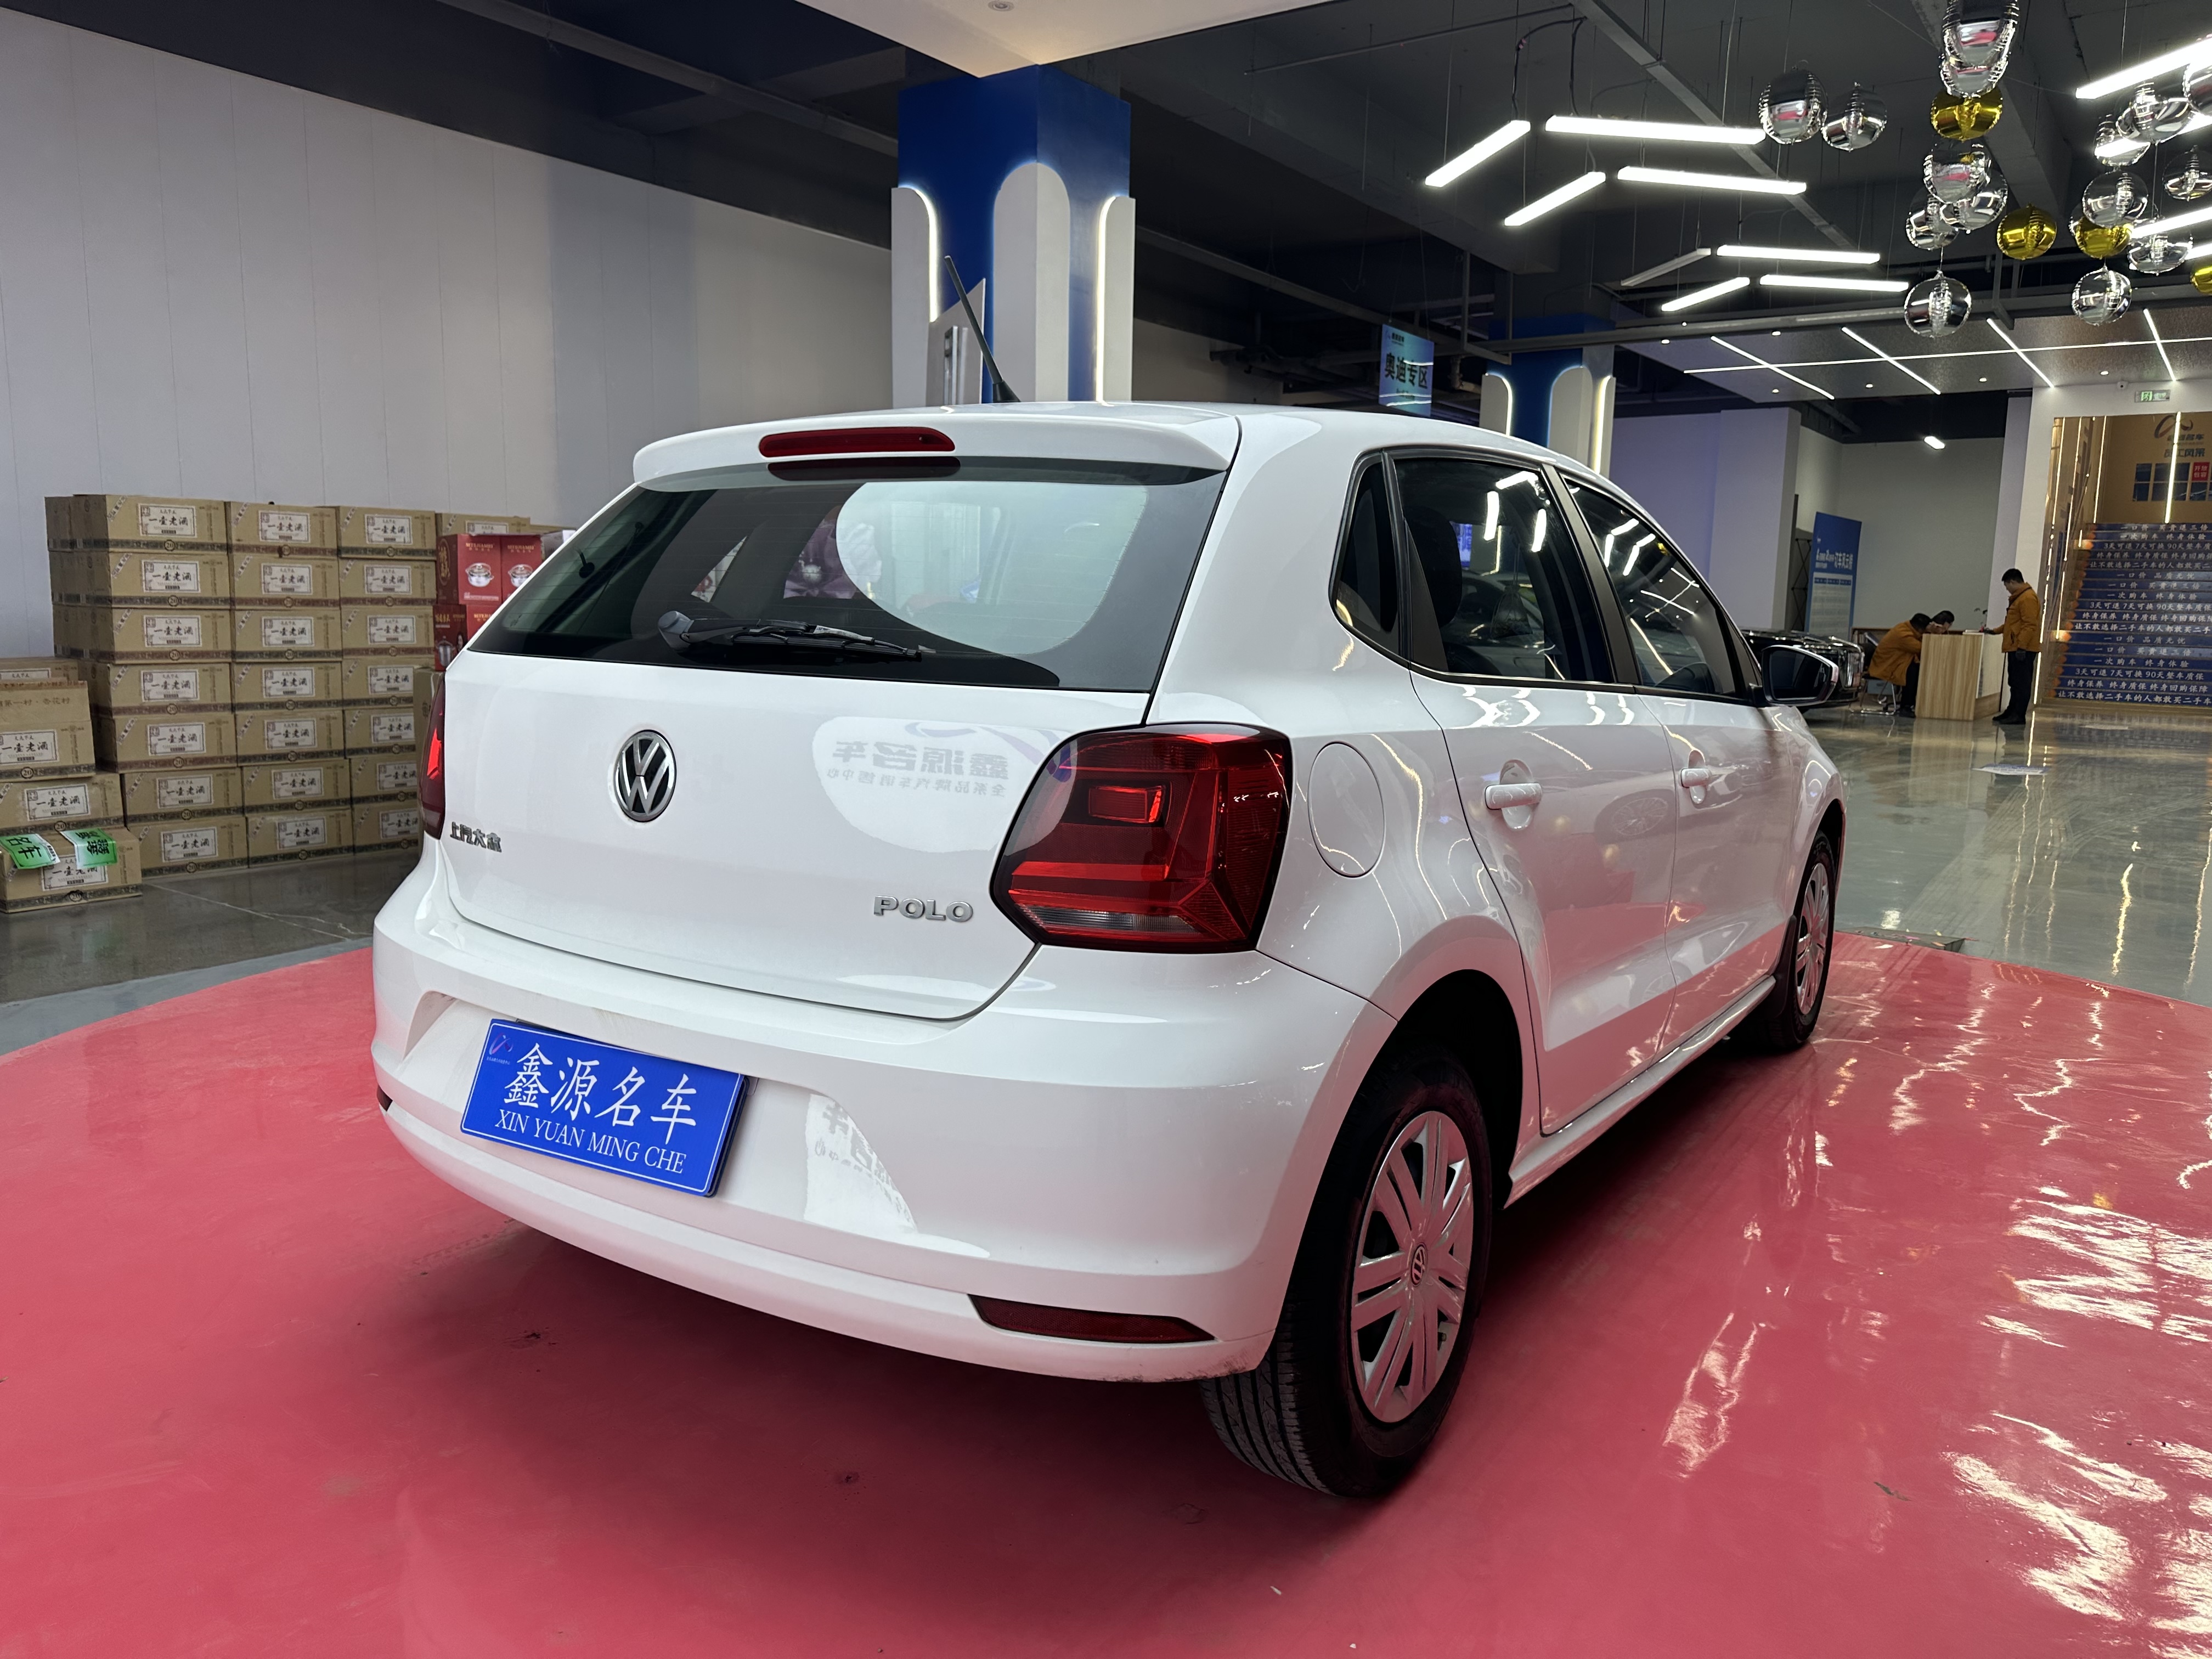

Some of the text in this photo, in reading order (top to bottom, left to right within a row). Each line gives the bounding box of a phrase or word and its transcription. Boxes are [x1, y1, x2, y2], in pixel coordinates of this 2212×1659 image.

[1385, 353, 1428, 388] 奥迪专区
[874, 895, 973, 923] POLO
[504, 1042, 697, 1145] 鑫源名车
[494, 1109, 687, 1174] XIN YUAN MING CHE
